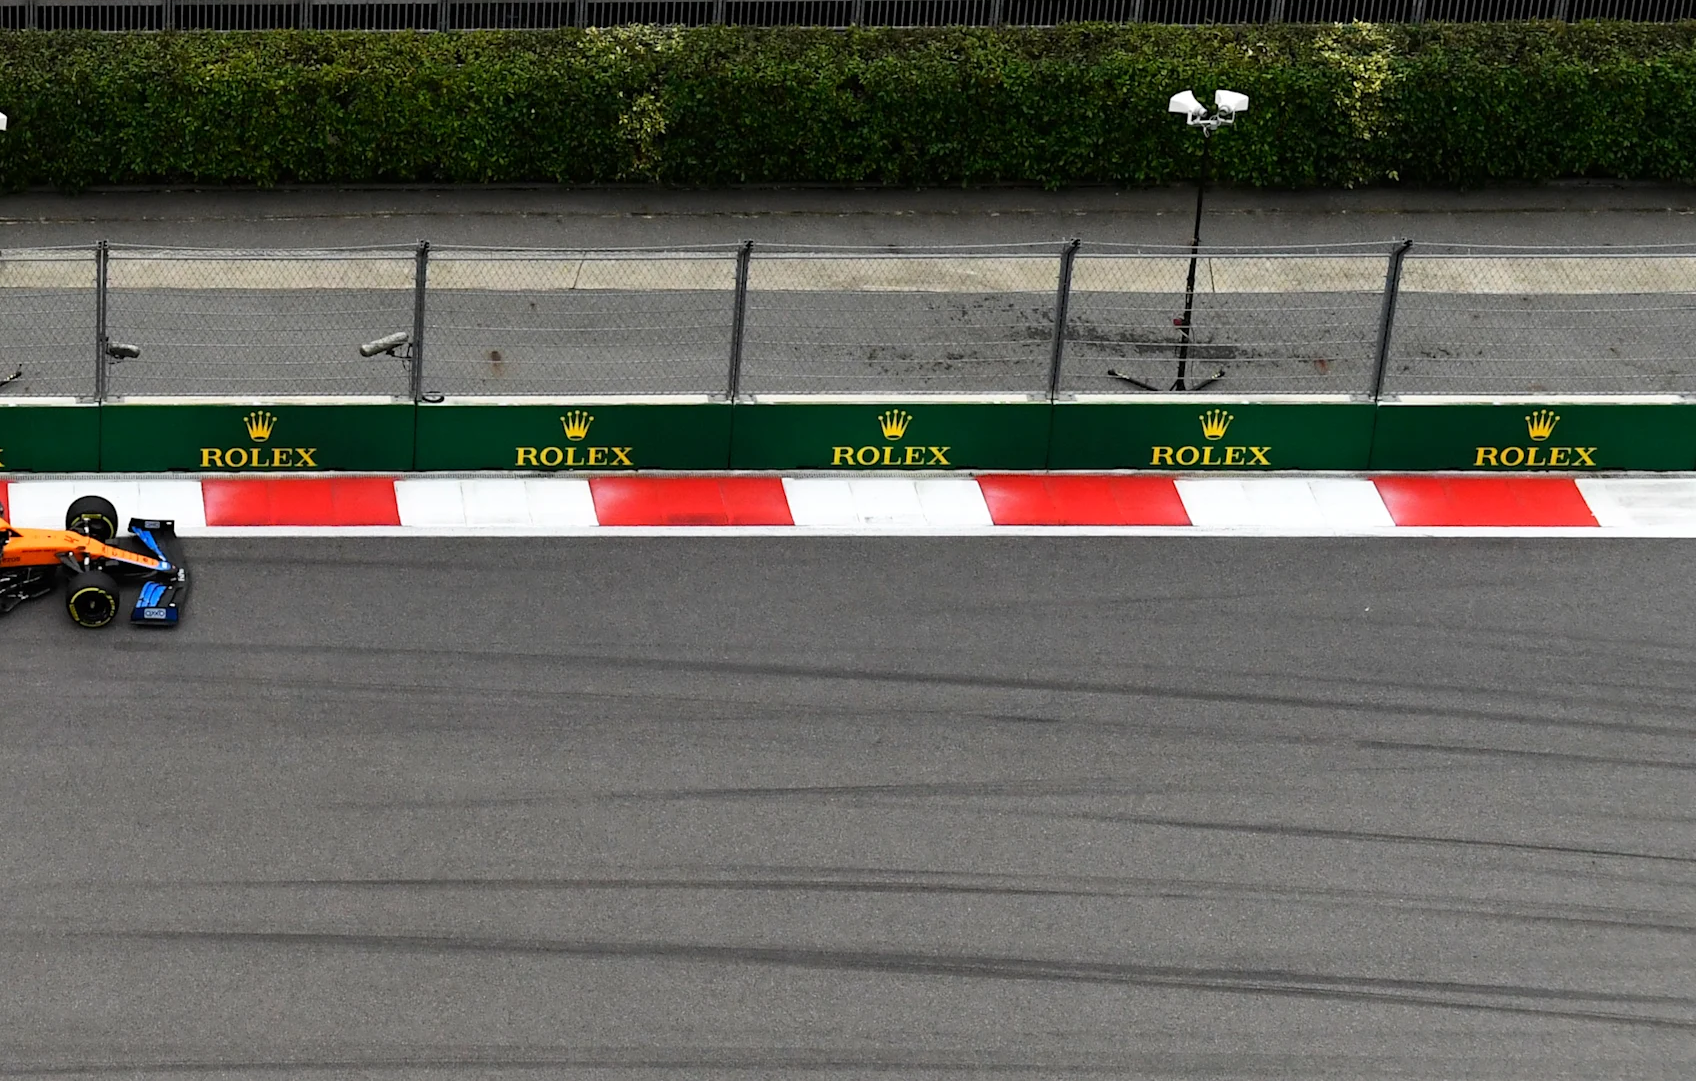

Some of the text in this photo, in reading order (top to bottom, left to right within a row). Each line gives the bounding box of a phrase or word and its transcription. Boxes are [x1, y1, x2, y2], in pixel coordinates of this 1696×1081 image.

[201, 447, 316, 468] ROLEX
[516, 446, 633, 466] ROLEX
[832, 445, 949, 466] ROLEX
[1151, 445, 1269, 466] ROLEX
[1474, 446, 1596, 467] ROLEX
